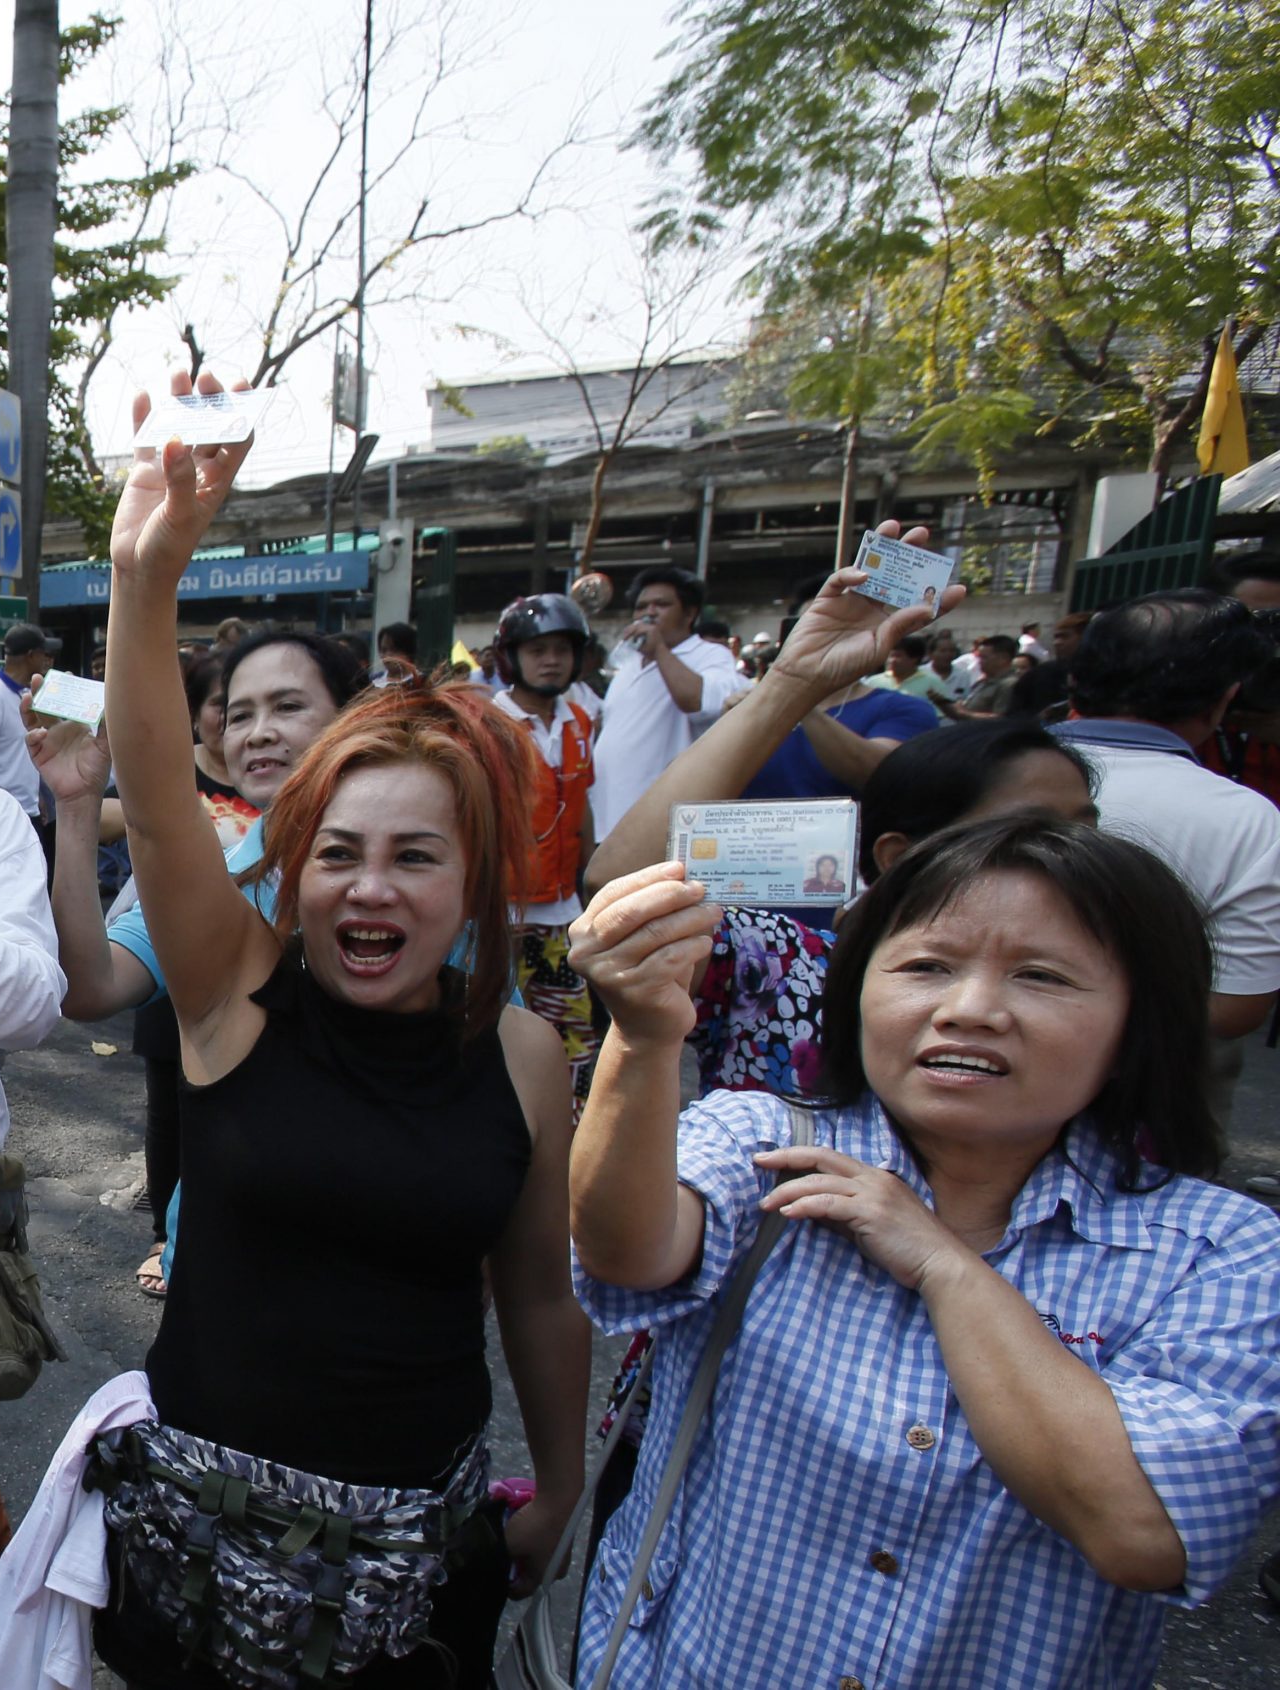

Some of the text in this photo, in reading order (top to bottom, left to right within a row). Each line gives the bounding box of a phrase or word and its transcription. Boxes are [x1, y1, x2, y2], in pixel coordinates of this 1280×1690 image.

[209, 564, 343, 589] ยินดีต้อนรับ
